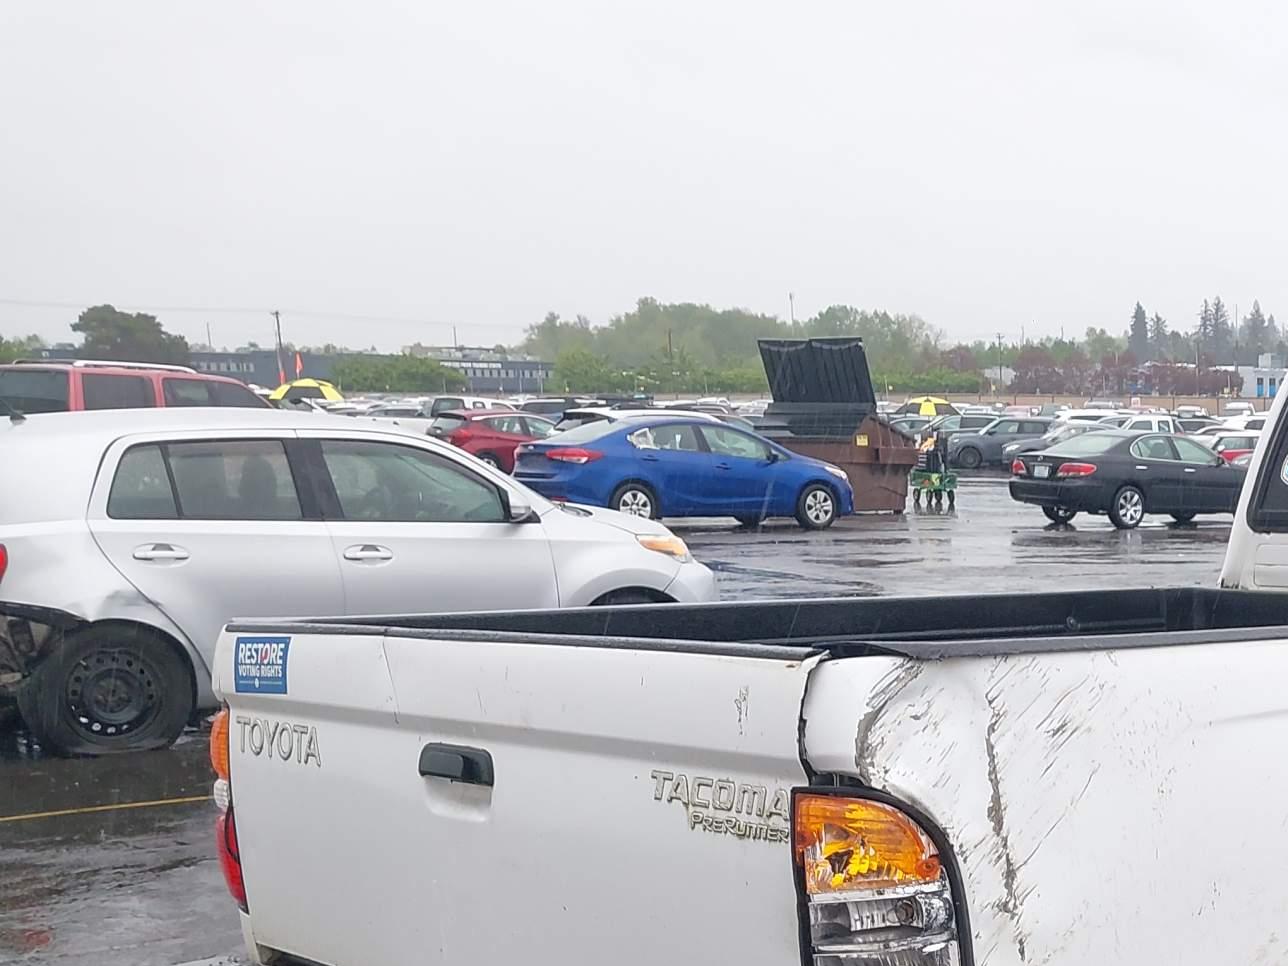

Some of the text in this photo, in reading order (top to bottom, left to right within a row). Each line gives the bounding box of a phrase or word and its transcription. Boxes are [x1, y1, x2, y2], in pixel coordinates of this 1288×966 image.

[239, 643, 285, 665] RESTORE
[239, 665, 282, 677] VOTING RIGHTS
[236, 715, 321, 768] TOYOTA
[651, 769, 790, 821] TACOMA
